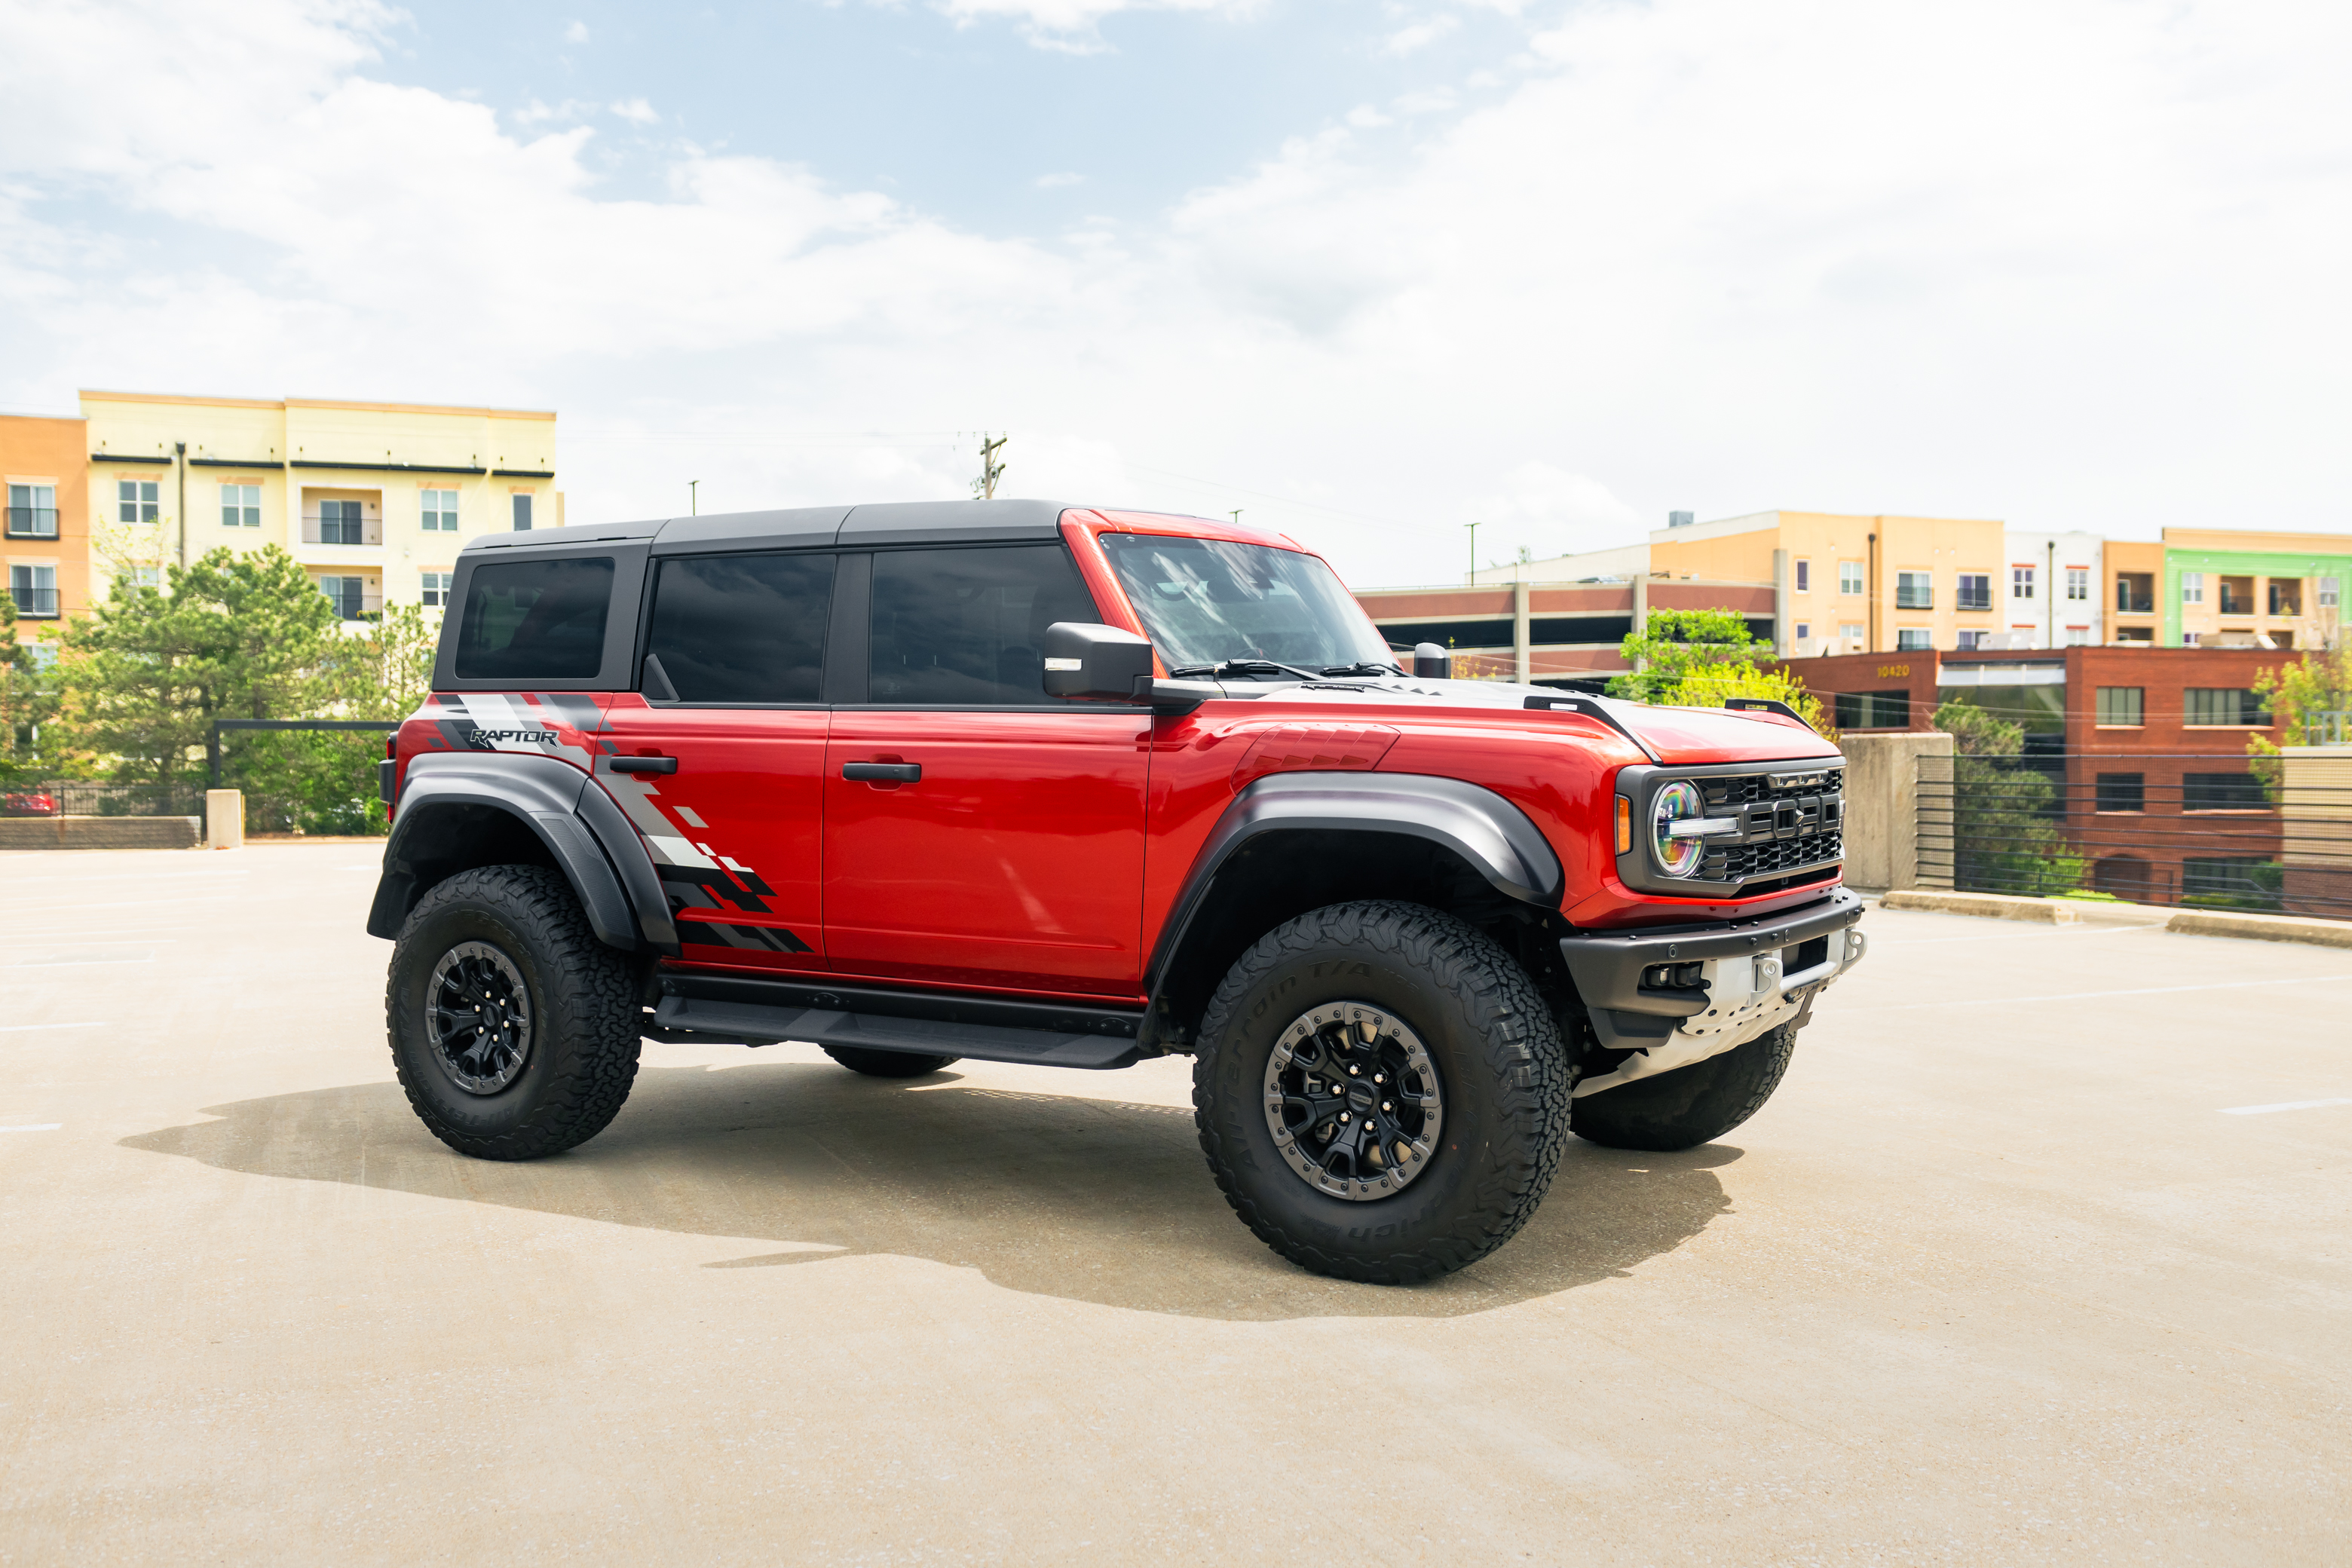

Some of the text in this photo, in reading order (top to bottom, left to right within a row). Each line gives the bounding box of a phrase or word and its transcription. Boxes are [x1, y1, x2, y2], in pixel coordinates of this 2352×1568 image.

[1877, 664, 1910, 678] 10420
[470, 729, 559, 750] RAPTOR
[1743, 793, 1840, 844] FORD
[1308, 958, 1371, 978] T/A
